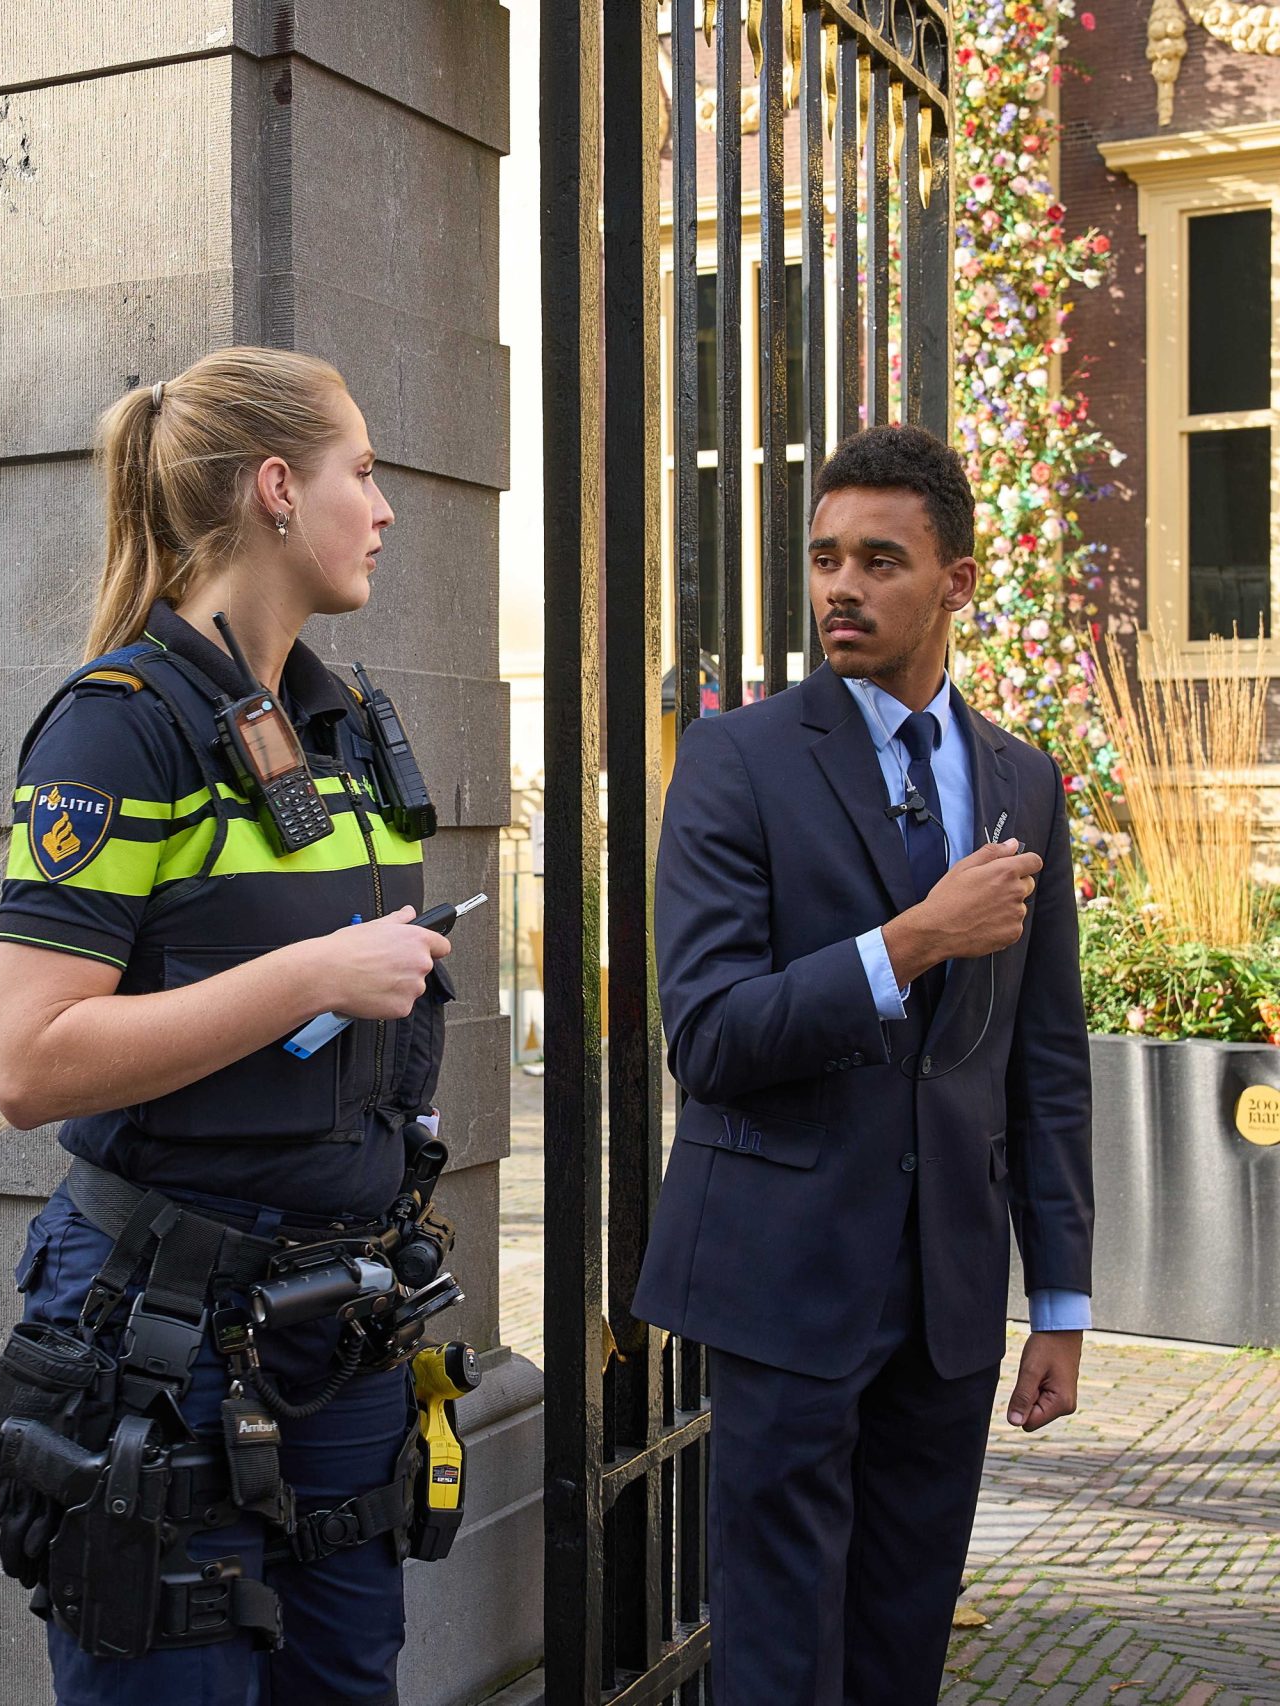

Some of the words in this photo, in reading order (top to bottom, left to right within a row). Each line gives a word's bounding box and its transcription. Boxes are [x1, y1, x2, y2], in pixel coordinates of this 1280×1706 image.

[38, 794, 106, 815] POLITIE
[1248, 1099, 1279, 1111] 200
[238, 1420, 274, 1434] Ambu
